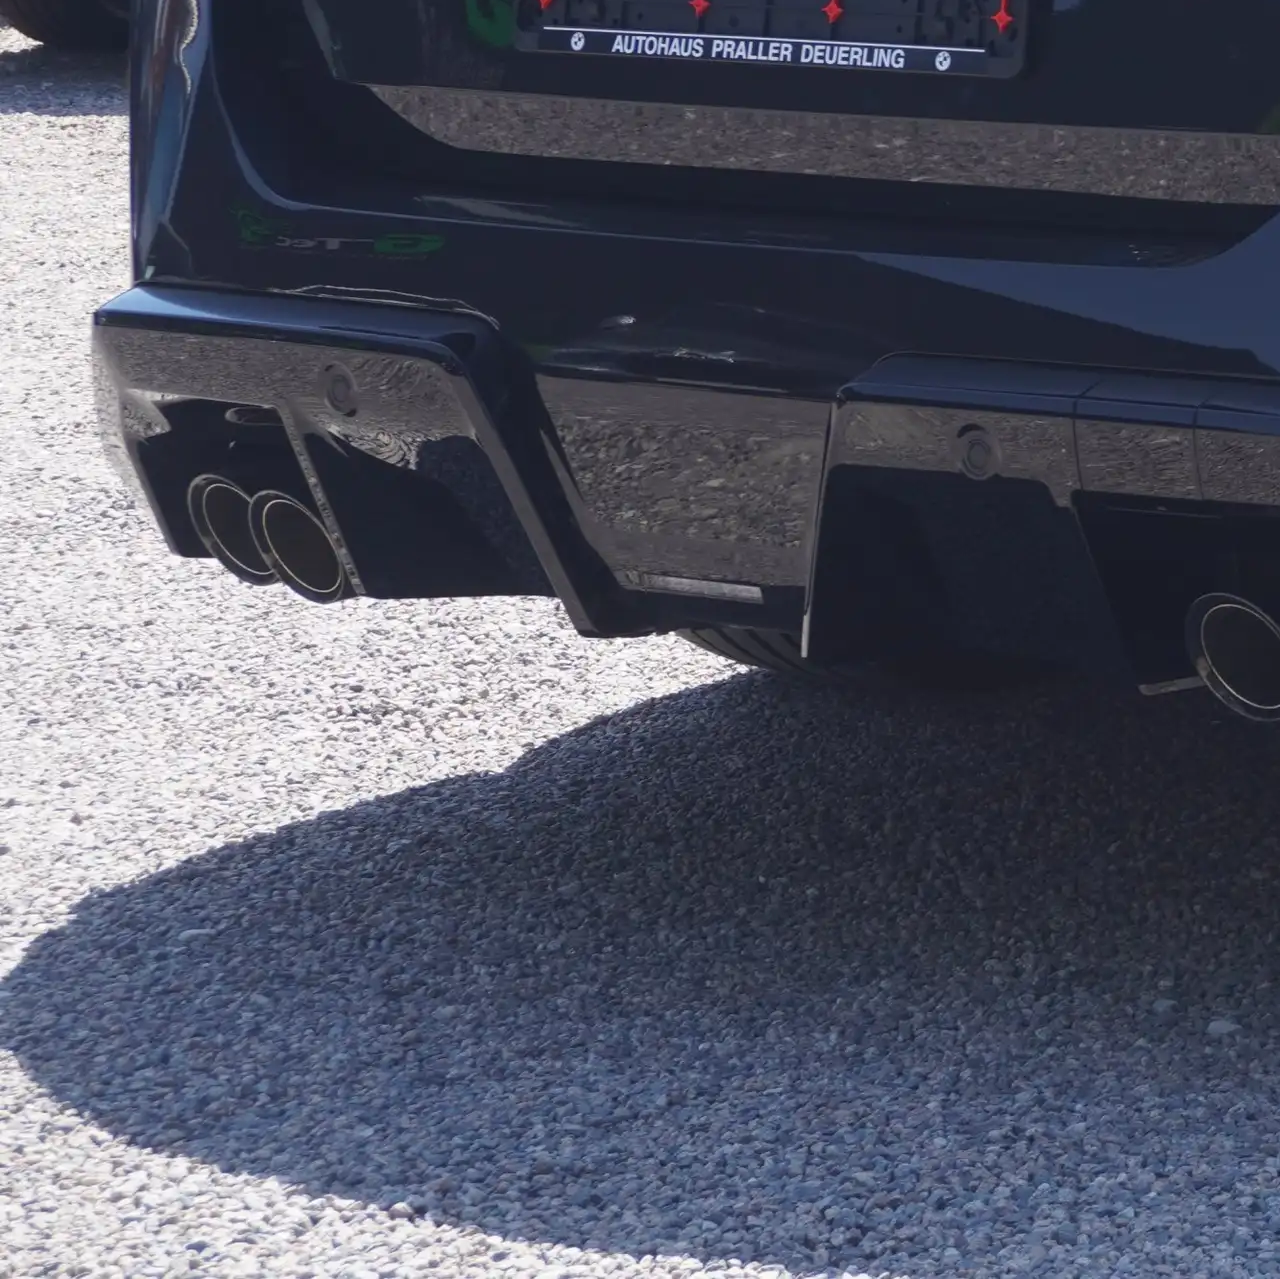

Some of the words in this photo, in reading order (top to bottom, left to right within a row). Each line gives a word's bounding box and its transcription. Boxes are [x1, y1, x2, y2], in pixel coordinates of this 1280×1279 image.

[611, 34, 704, 57] AUTOHAUS
[711, 39, 792, 62] PRALLER
[800, 44, 905, 69] DEUERLING
